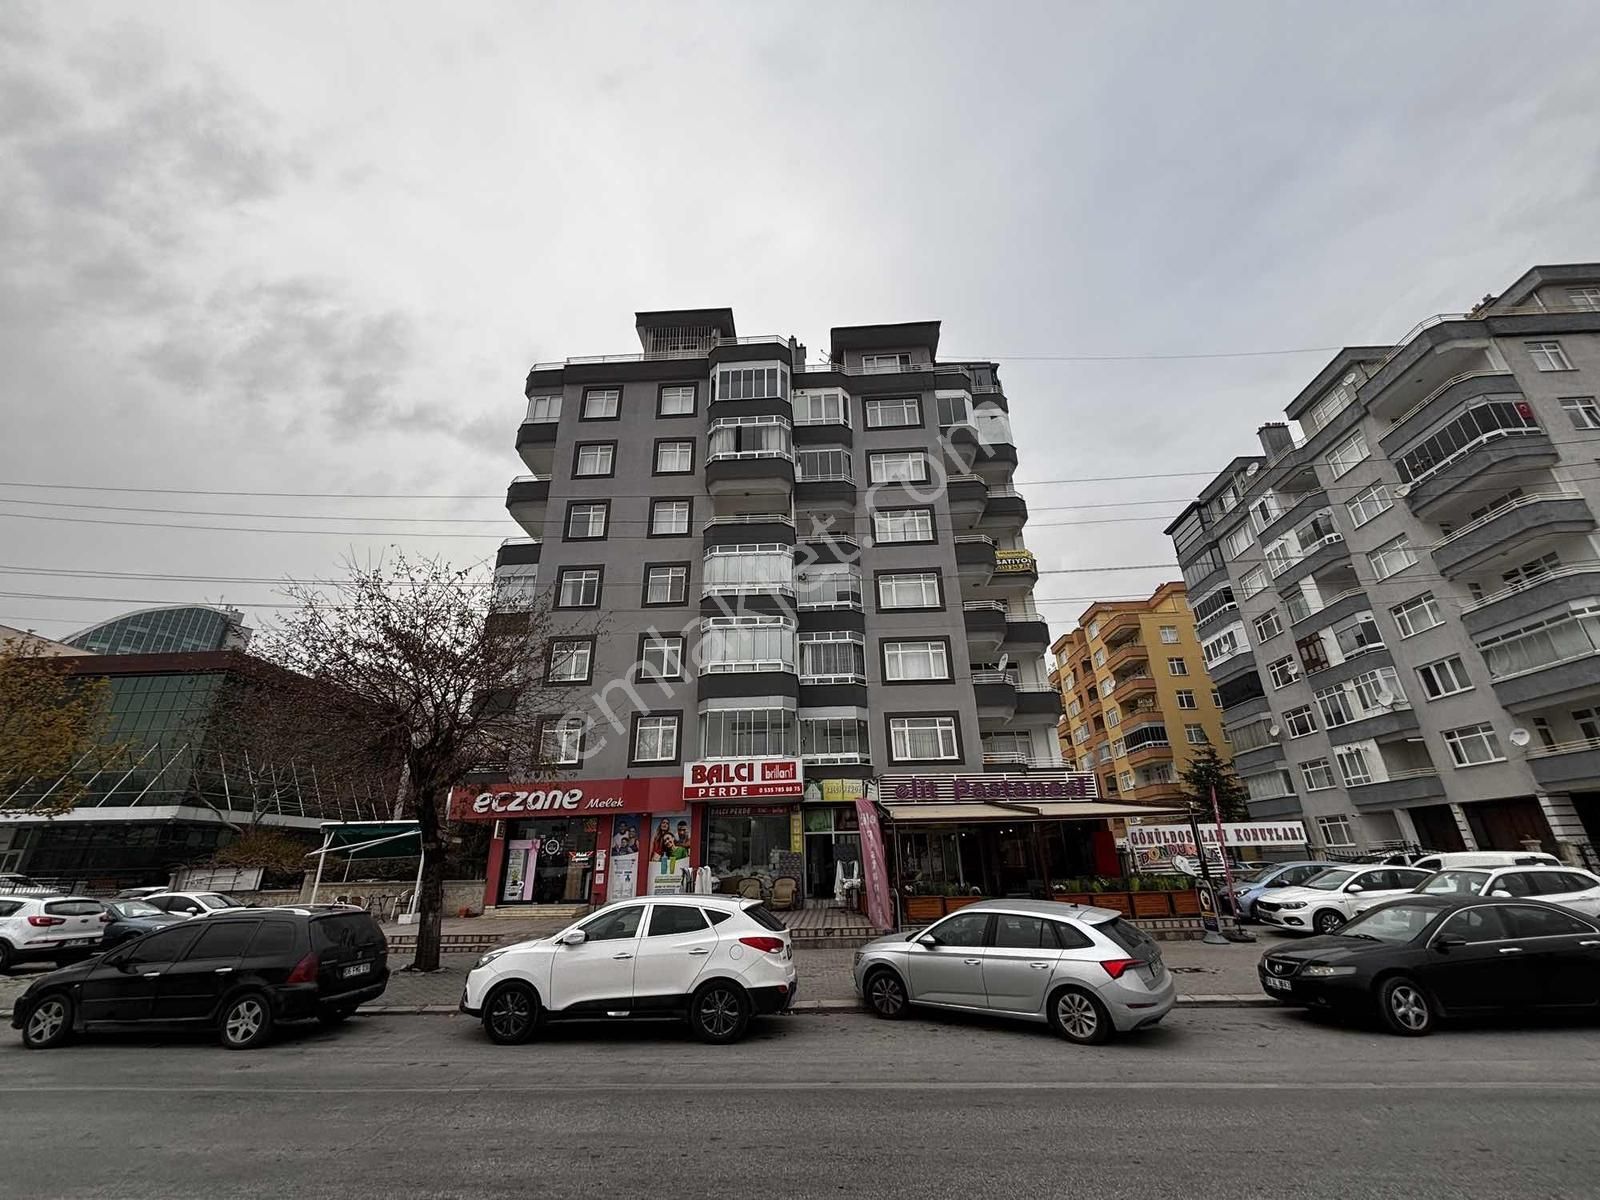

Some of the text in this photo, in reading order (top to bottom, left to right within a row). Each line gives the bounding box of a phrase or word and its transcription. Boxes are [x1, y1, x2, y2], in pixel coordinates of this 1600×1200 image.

[692, 763, 754, 785] BALCI
[765, 764, 794, 780] brillant
[473, 789, 624, 813] eczane Melek
[698, 786, 748, 797] PERDE
[1131, 827, 1305, 845] GÖNÜLDOSLAI KONUTLARI
[1140, 843, 1219, 866] DONDURA
